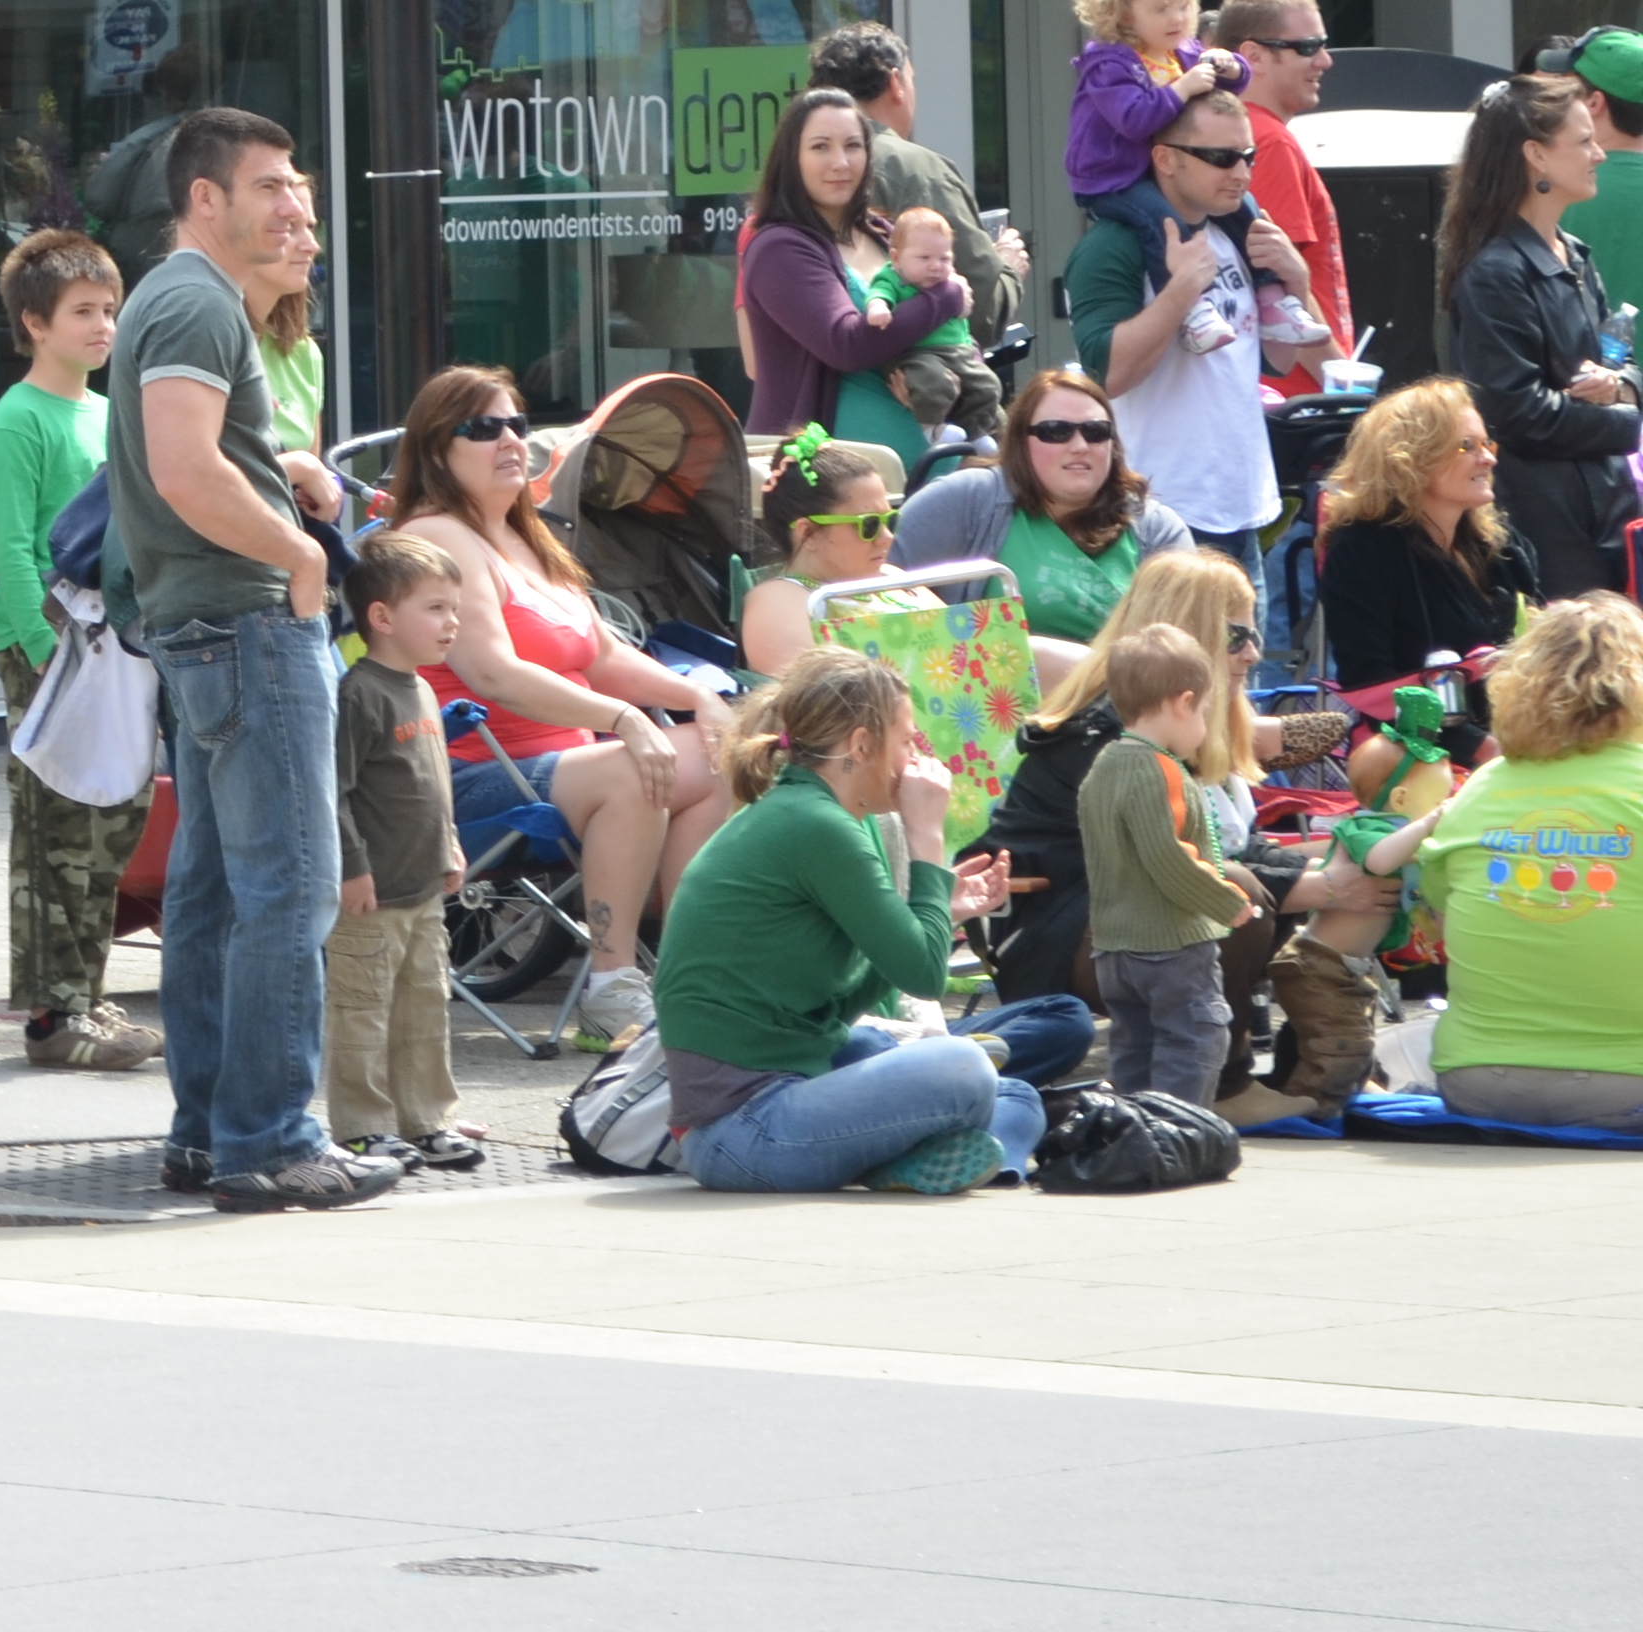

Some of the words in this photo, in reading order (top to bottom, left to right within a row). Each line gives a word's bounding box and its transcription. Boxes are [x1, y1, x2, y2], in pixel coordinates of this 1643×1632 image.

[444, 79, 668, 180] wntown
[440, 209, 682, 243] downtowndentists.com
[1479, 828, 1532, 854] WET
